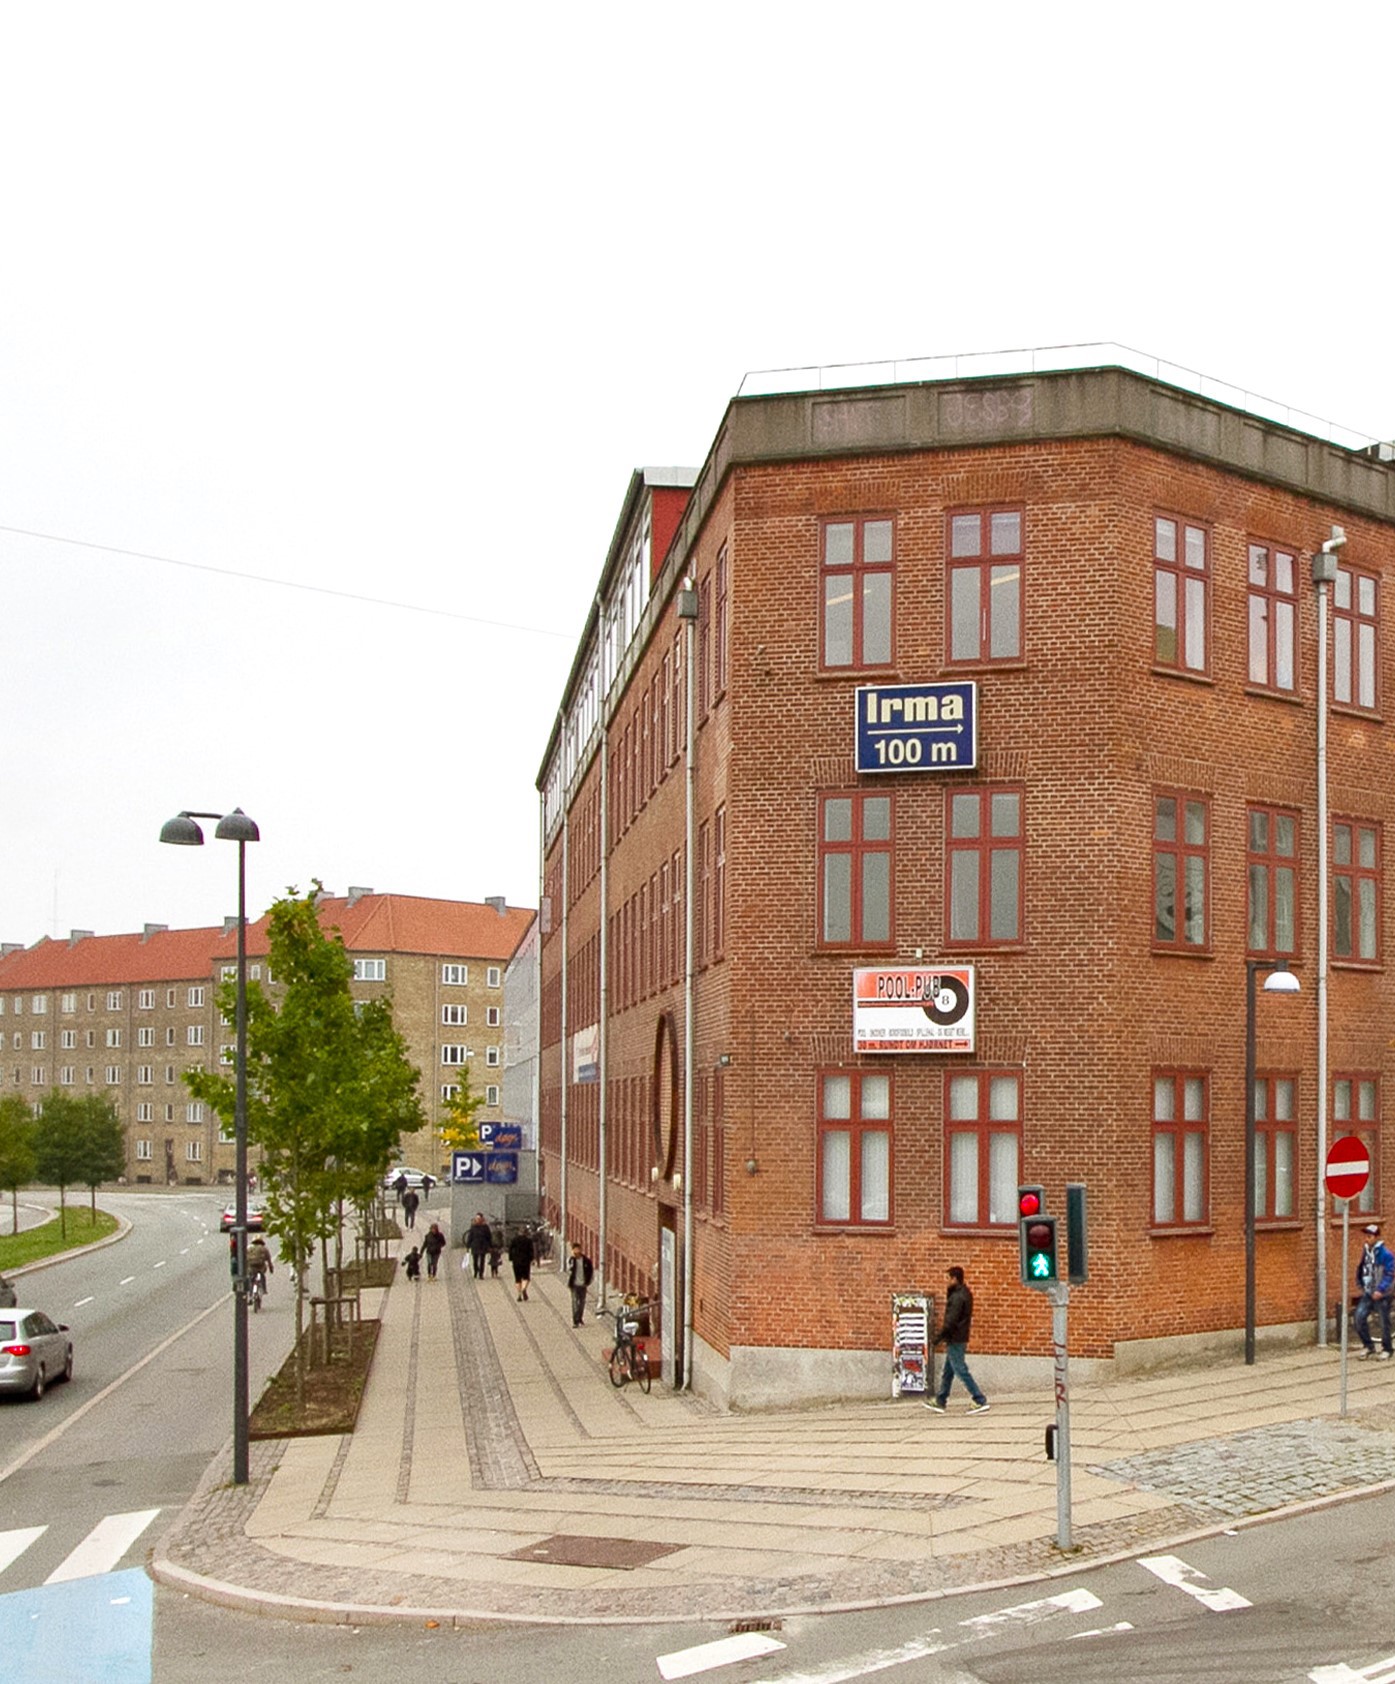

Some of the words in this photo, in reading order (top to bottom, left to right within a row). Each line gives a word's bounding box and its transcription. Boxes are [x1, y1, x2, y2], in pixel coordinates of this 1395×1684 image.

[867, 693, 964, 723] Irma
[874, 738, 922, 764] 100
[931, 741, 957, 762] m
[941, 995, 950, 1006] 8
[481, 1125, 492, 1139] P
[456, 1157, 471, 1177] P
